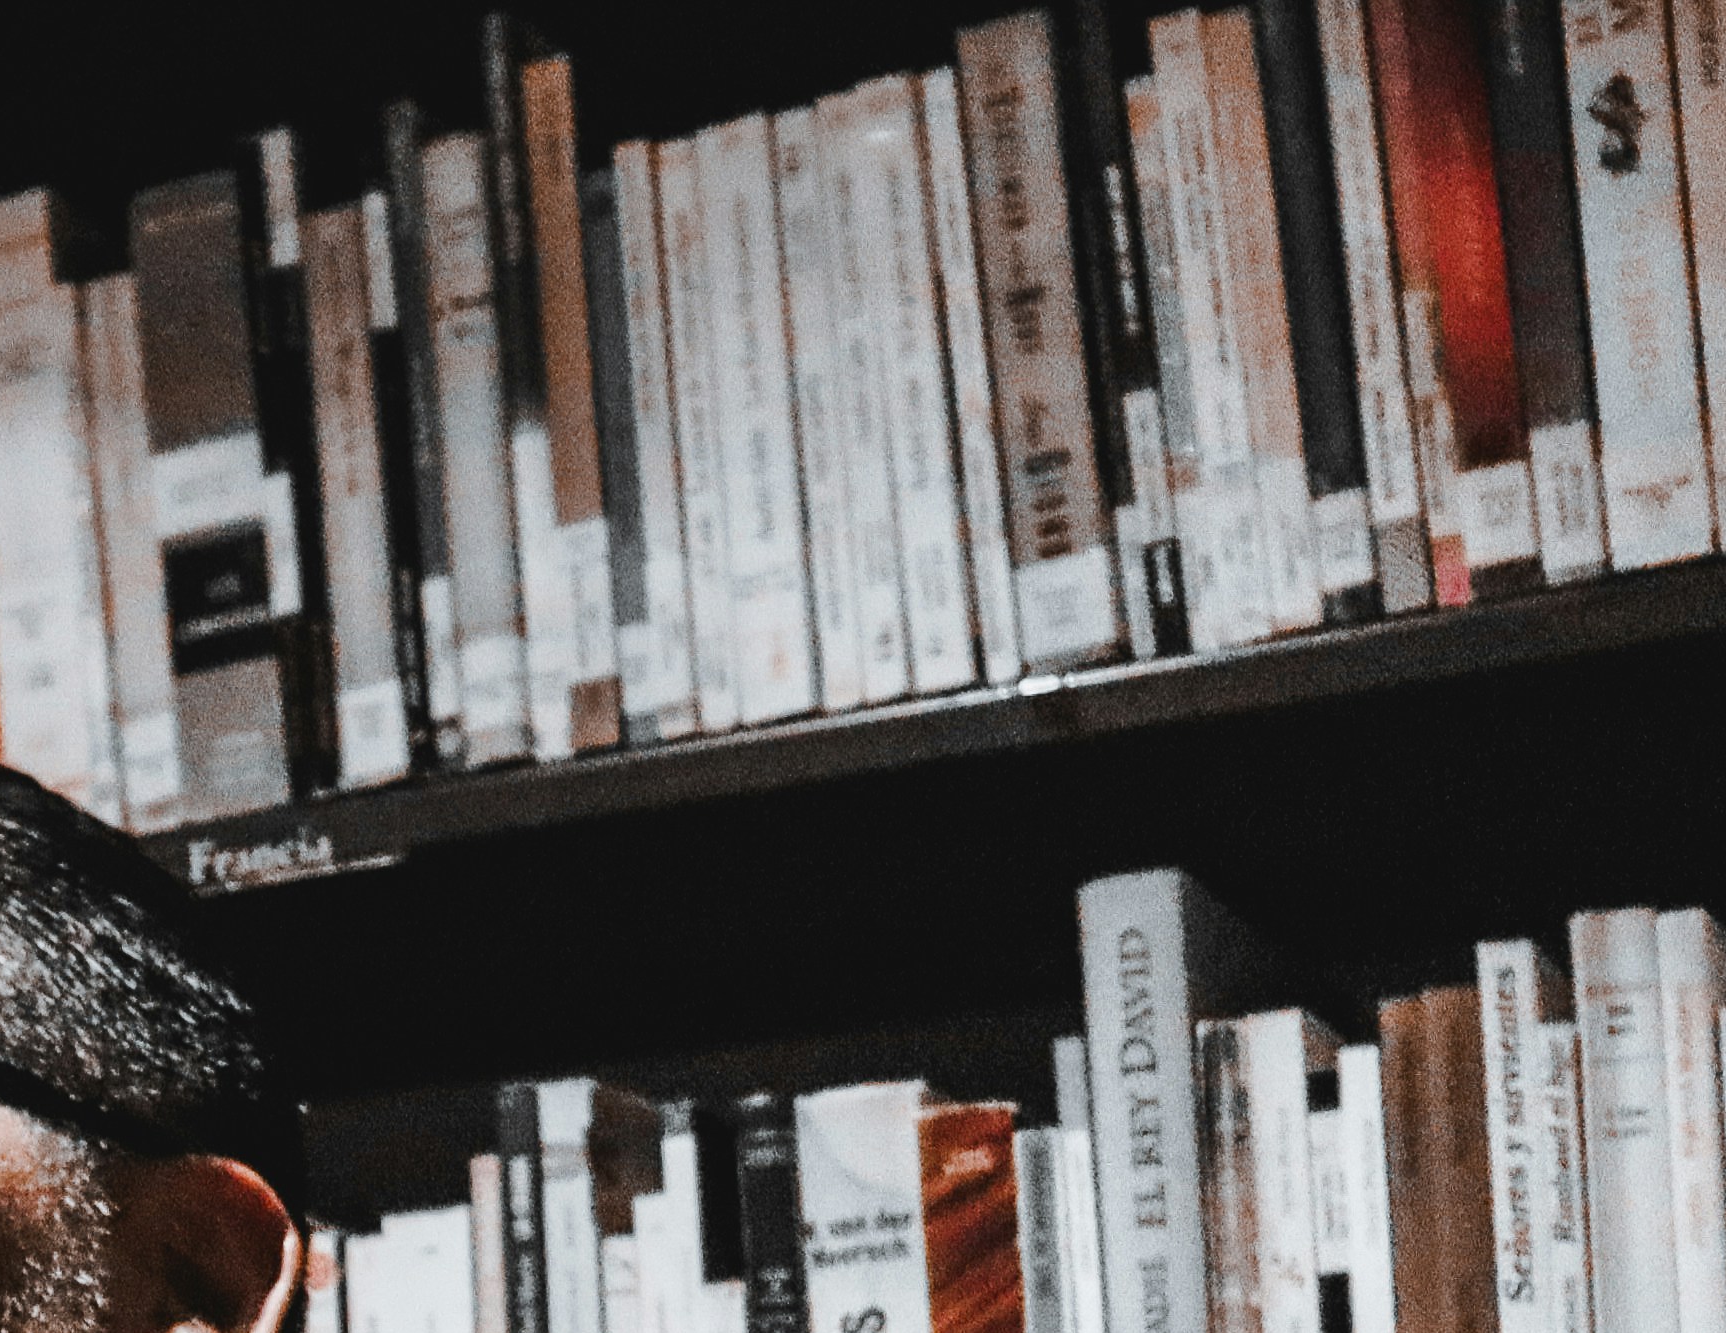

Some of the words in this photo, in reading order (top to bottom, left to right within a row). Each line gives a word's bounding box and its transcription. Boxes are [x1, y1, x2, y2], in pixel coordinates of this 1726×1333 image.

[1114, 928, 1159, 1076] DAVID
[1128, 1096, 1164, 1169] REY
[1504, 1133, 1532, 1154] y
[1135, 1183, 1167, 1229] EL
[1500, 1168, 1536, 1304] Señores
